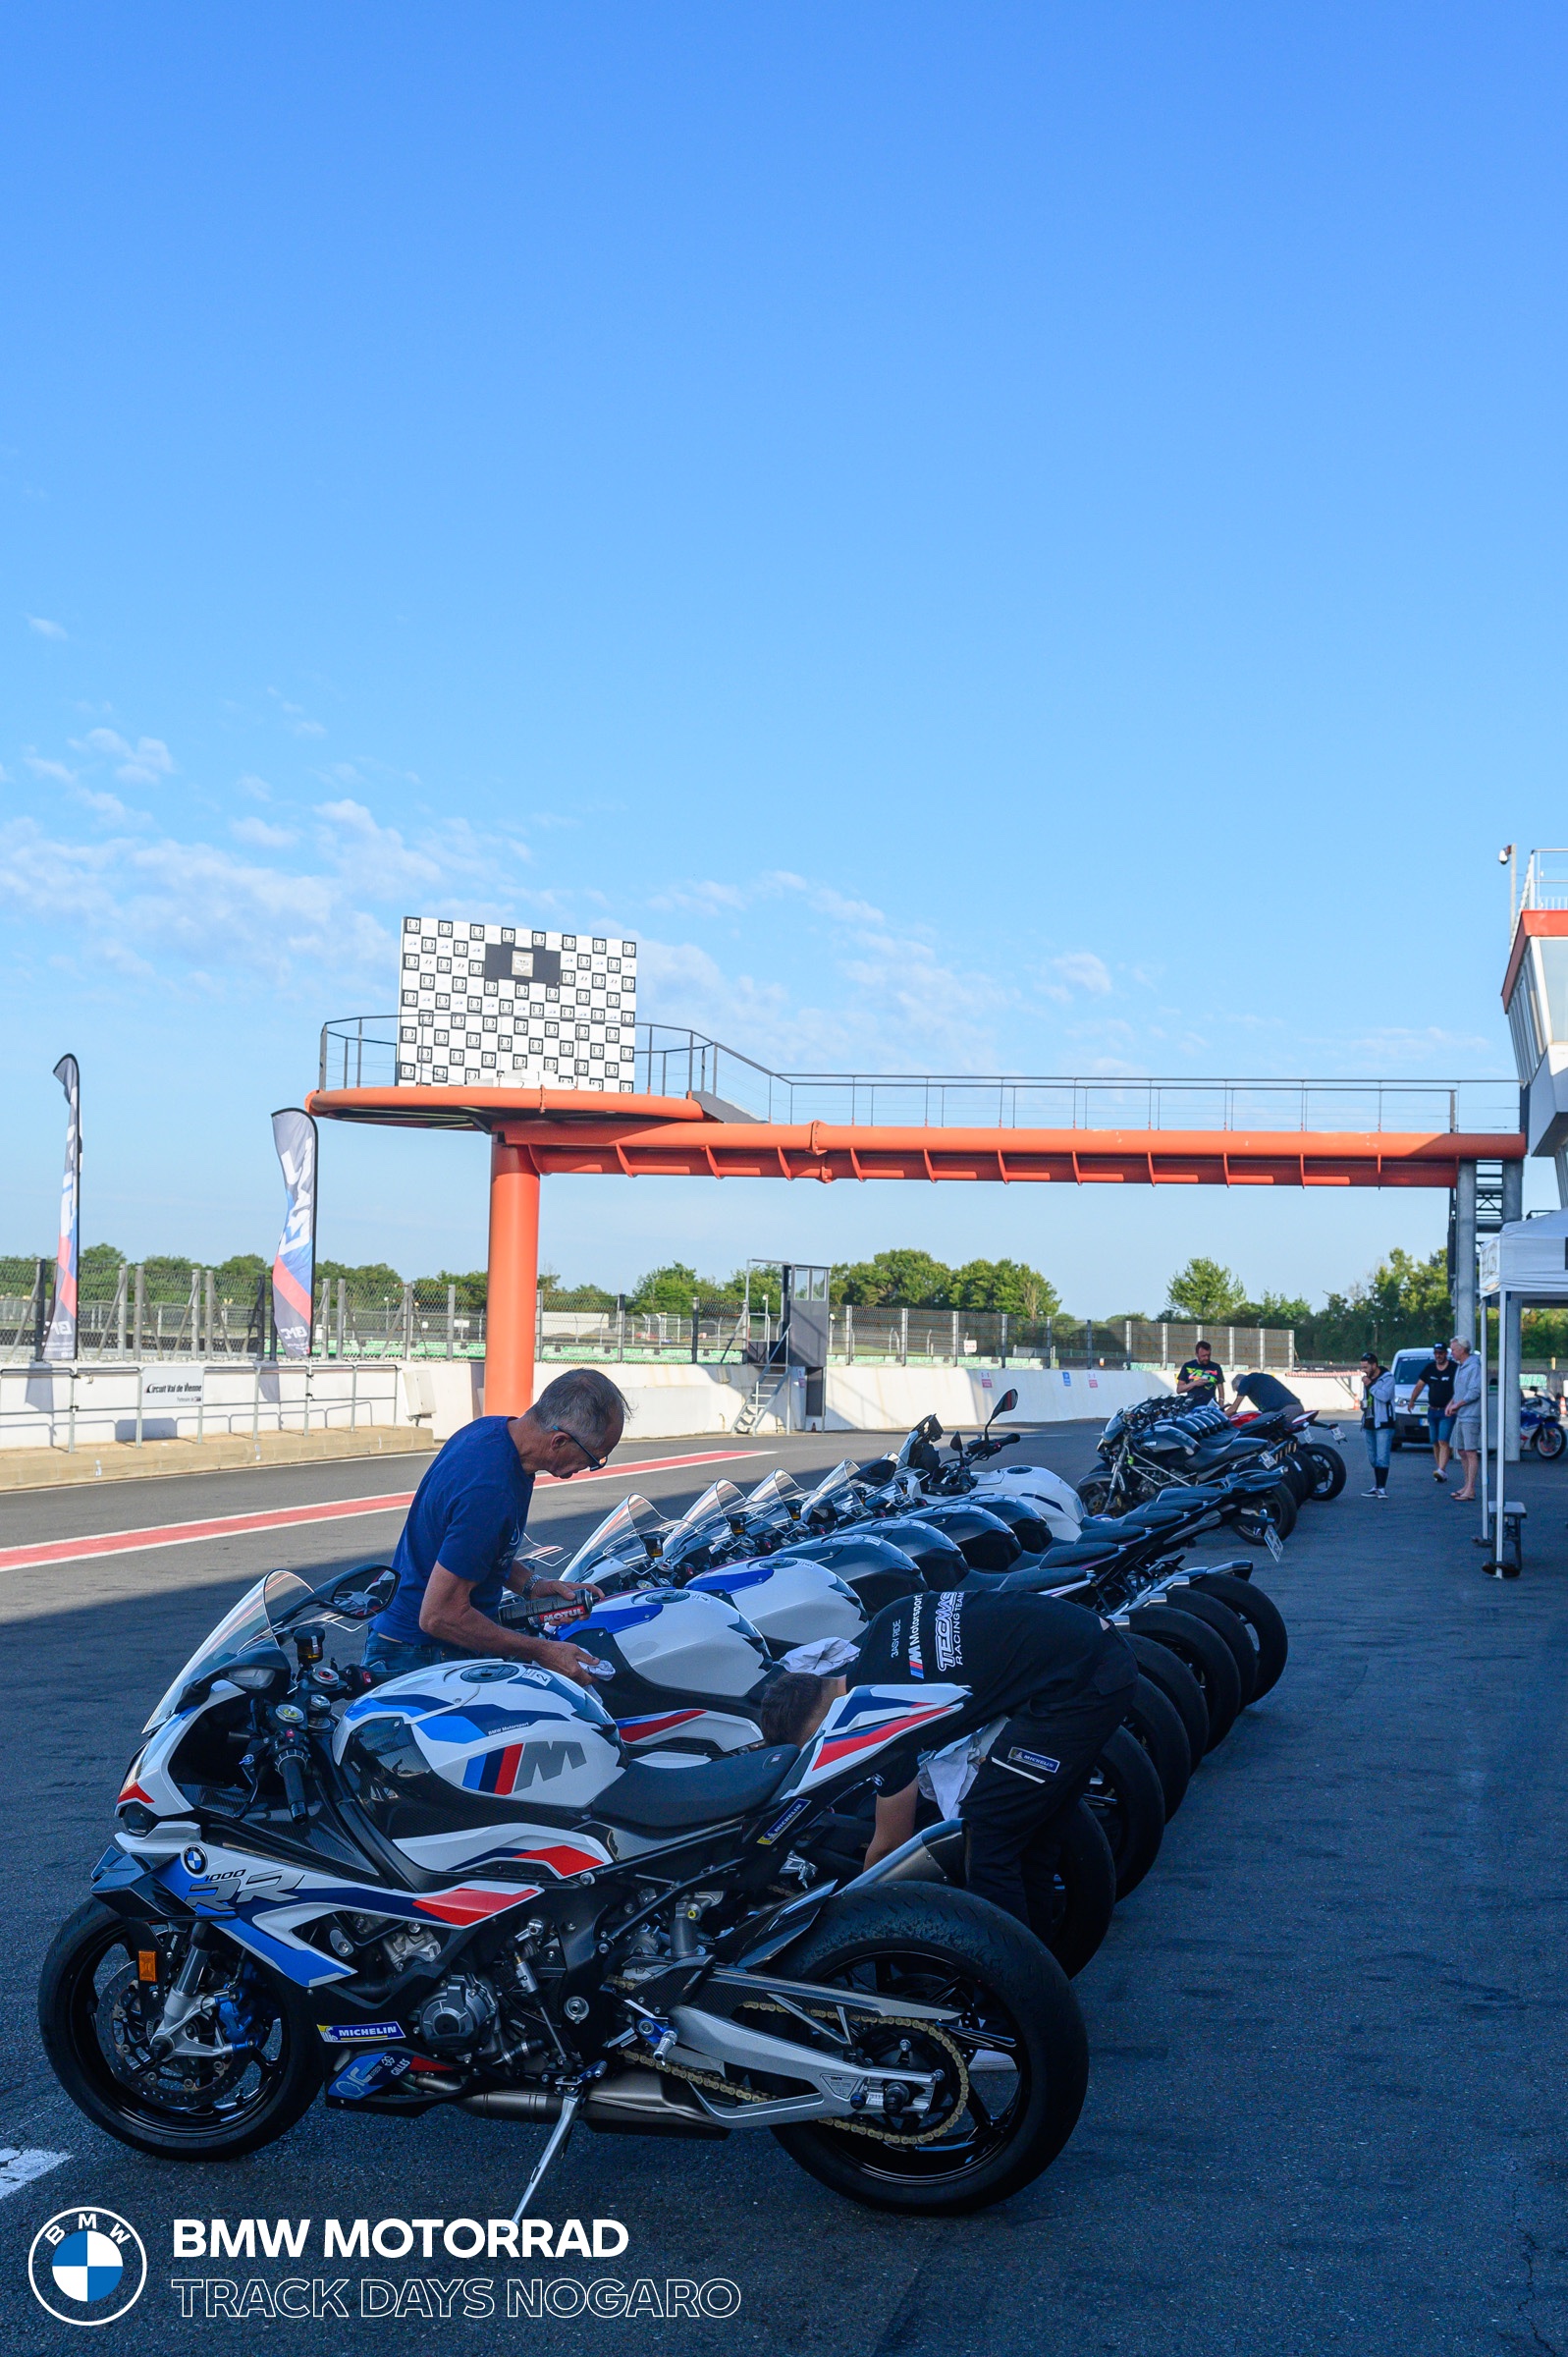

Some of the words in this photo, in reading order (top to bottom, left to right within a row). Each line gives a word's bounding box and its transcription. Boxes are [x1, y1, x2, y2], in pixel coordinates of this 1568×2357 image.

[144, 1383, 166, 1394] Circuit
[167, 1384, 176, 1393] Val
[184, 1382, 202, 1393] Vienne
[543, 1608, 585, 1622] MOTUL
[909, 1593, 923, 1646] Motorsport
[953, 1613, 963, 1666] RACING
[502, 1722, 529, 1731] Motorsport
[1023, 1754, 1055, 1769] MICHELIN
[774, 1803, 803, 1833] MICHELIN
[204, 1869, 246, 1883] 1000
[184, 1869, 305, 1912] RR
[338, 2025, 397, 2037] MICHELIN
[390, 2057, 411, 2076] GILLES
